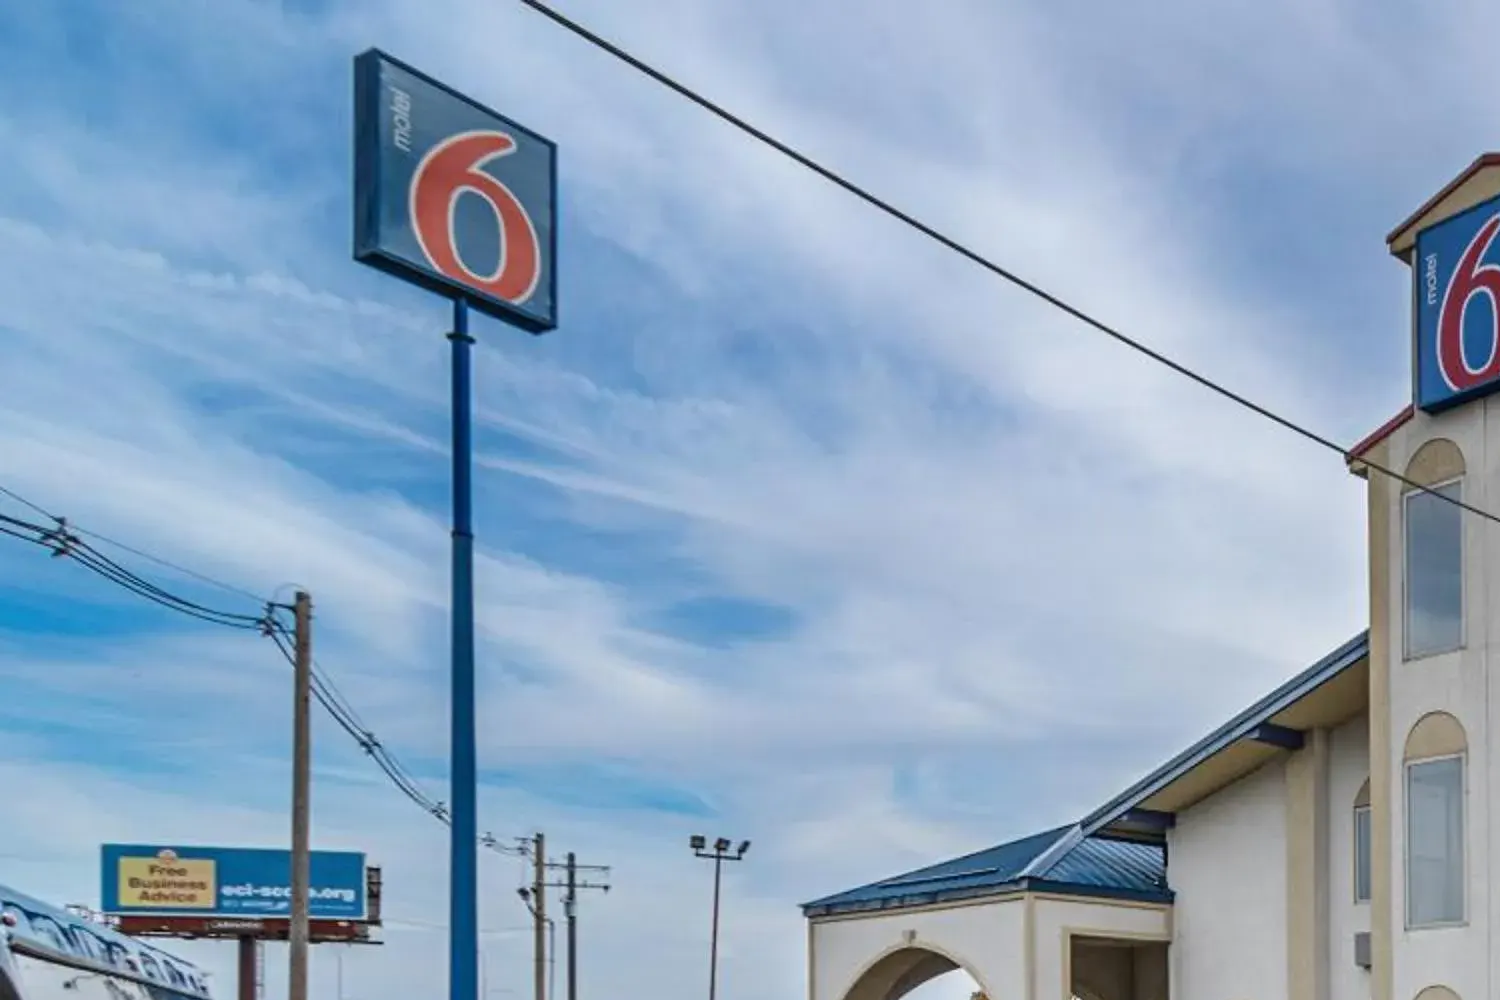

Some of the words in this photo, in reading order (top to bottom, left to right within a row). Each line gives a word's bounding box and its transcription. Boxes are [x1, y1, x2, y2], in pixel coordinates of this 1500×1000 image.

[409, 129, 541, 304] 6
[1425, 254, 1437, 305] motel
[148, 864, 187, 877] Free
[128, 877, 207, 890] Business
[138, 890, 197, 902] Advice
